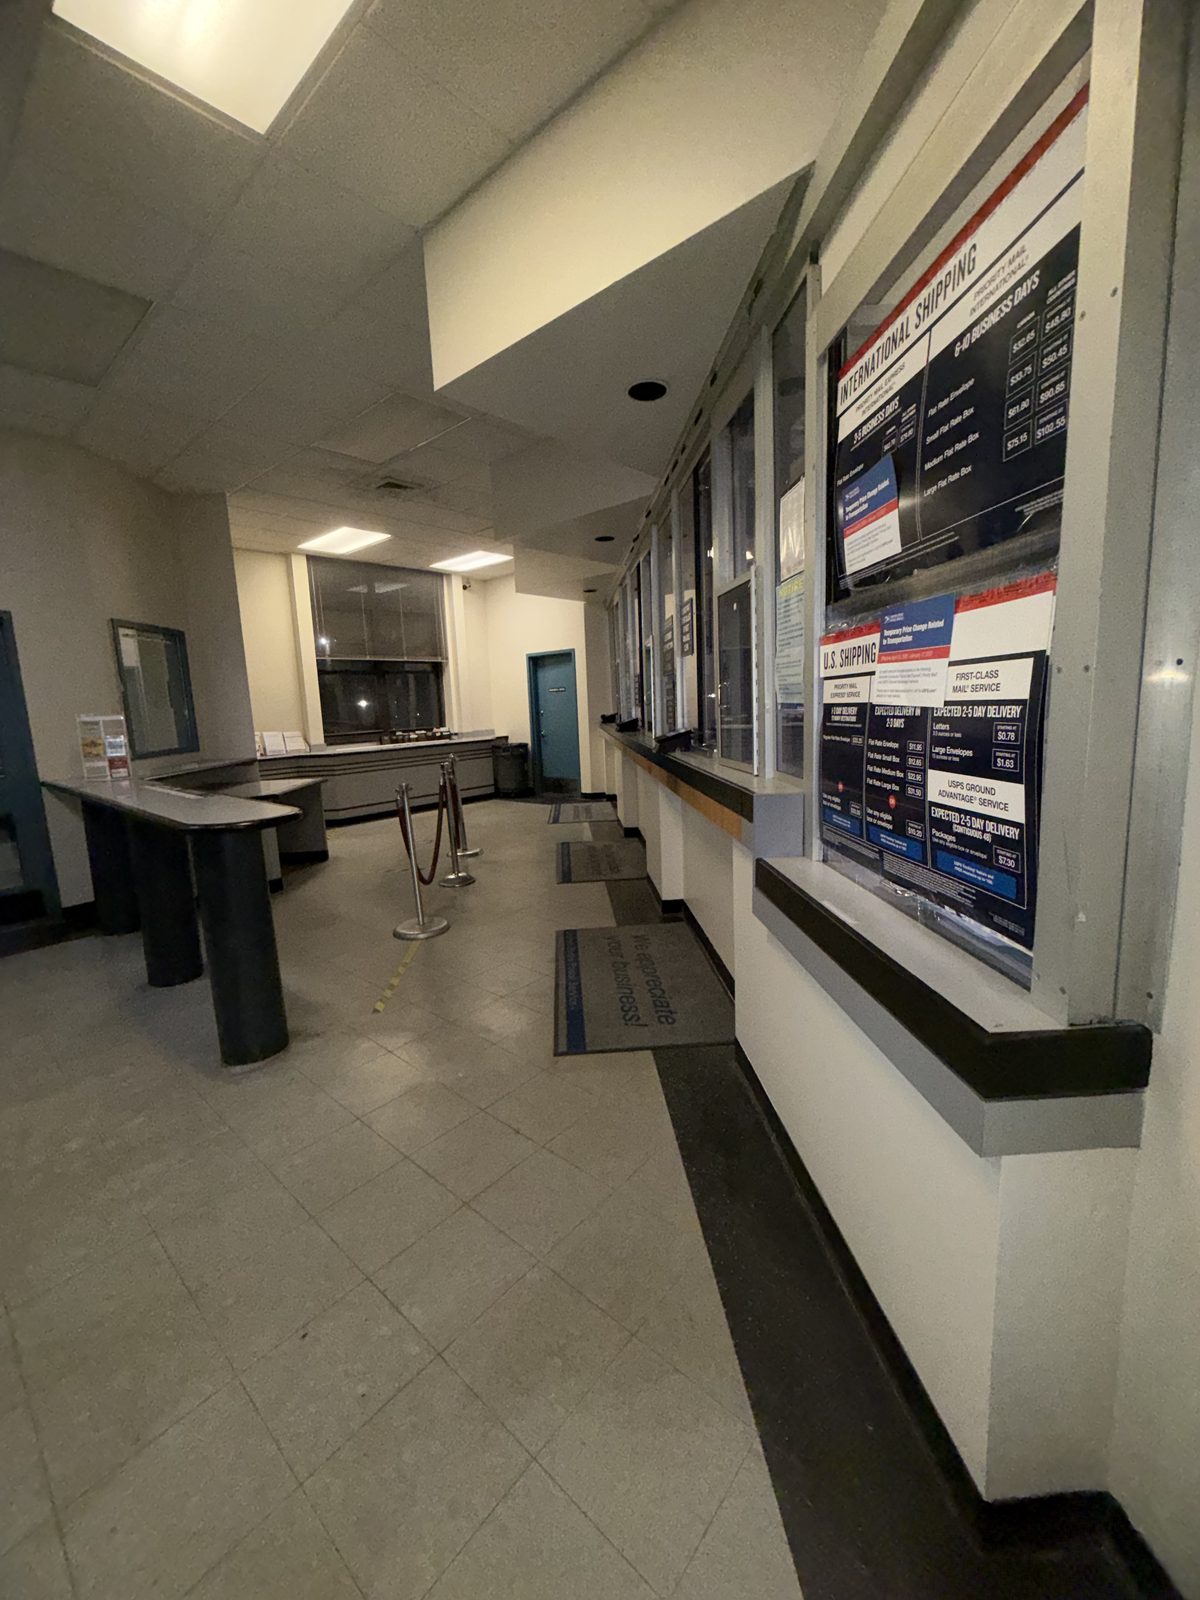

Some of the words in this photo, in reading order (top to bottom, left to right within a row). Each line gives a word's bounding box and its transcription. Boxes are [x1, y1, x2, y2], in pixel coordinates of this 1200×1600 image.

[954, 333, 971, 357] 6-10
[971, 294, 1014, 344] BUSINESS
[1014, 269, 1041, 306] DAYS
[840, 316, 911, 405] INTERNATIONAL
[915, 243, 977, 329] SHIPPING
[938, 397, 949, 410] Rate
[949, 378, 975, 401] Envelope
[886, 396, 900, 418] DAYS
[926, 430, 939, 445] Small
[939, 423, 949, 435] Flat
[949, 415, 962, 429] Rate
[962, 406, 975, 419] Box
[1036, 416, 1066, 439] $102.55
[1007, 432, 1028, 450] $75.15
[924, 454, 944, 471] Medium
[944, 447, 954, 459] Flat
[954, 439, 967, 452] Rate
[967, 431, 980, 444] Box
[924, 485, 937, 497] Large
[938, 478, 947, 489] Flat
[947, 472, 960, 483] Rate
[960, 464, 972, 477] Box
[901, 625, 912, 633] Price
[913, 623, 927, 632] Change
[823, 652, 837, 669] U.S.
[840, 642, 877, 668] SHIPPING
[956, 670, 999, 681] FIRST-CLASS
[970, 683, 1001, 693] SERVICE
[875, 706, 894, 715] EXPECTED
[894, 706, 914, 716] DELIVERY
[933, 706, 961, 717] EXPECTED
[962, 706, 972, 717] 2-5
[973, 705, 986, 718] DAY
[893, 718, 905, 728] DAYS
[933, 722, 950, 731] Letters
[998, 731, 1015, 741] $0.78
[932, 746, 945, 754] Large
[946, 747, 973, 757] Envelopes
[997, 758, 1014, 768] $1.63
[948, 780, 964, 790] USPS
[965, 783, 996, 796] GROUND
[979, 798, 1009, 811] SERVICE
[931, 806, 959, 823] EXPECTED
[960, 814, 971, 826] 2-5
[971, 817, 985, 831] DAY
[985, 821, 1020, 840] DELIVERY
[932, 828, 956, 842] Packages
[952, 823, 982, 840] (CONTIGUOUS
[998, 855, 1015, 868] $7.30
[612, 961, 648, 1028] business!
[637, 951, 678, 1026] appreciate
